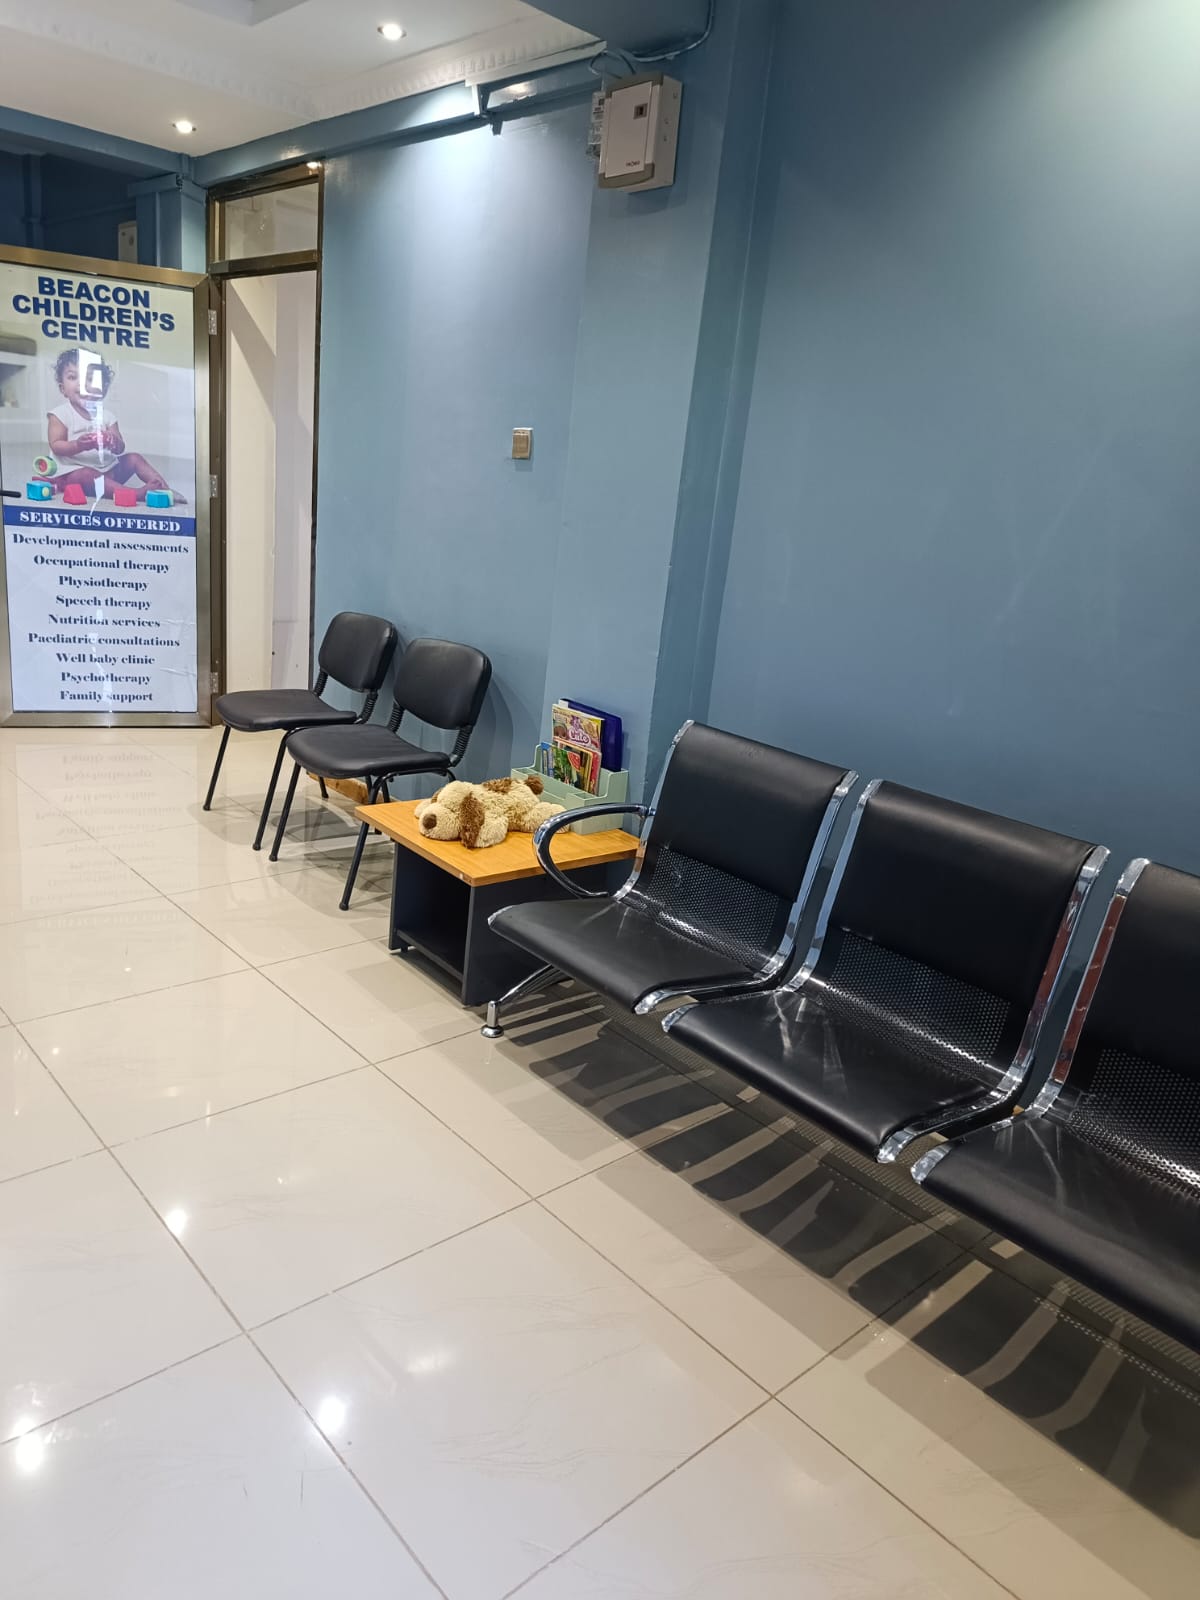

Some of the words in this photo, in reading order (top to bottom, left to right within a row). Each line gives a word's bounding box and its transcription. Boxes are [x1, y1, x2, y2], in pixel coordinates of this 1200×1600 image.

[38, 276, 150, 308] BEACON
[12, 294, 175, 332] CHILDREN'S
[41, 319, 150, 349] CENTRE
[20, 511, 101, 527] SERVICES
[104, 517, 180, 532] OFFERED
[12, 533, 110, 549] Developmental
[113, 541, 189, 553] assessments
[33, 555, 120, 568] Occupational
[123, 560, 170, 573] therapy
[59, 576, 149, 591] Physiotherapy
[56, 595, 101, 607] Speech
[104, 597, 151, 610] therapy
[48, 614, 109, 625] Nutrition
[112, 617, 160, 627] services
[28, 633, 96, 644] Paediatric
[98, 636, 180, 646] consultations
[56, 653, 86, 663] Well
[89, 654, 118, 666] baby
[121, 655, 155, 664] clinic
[61, 672, 151, 685] Psychotherapy
[60, 691, 102, 703] Family
